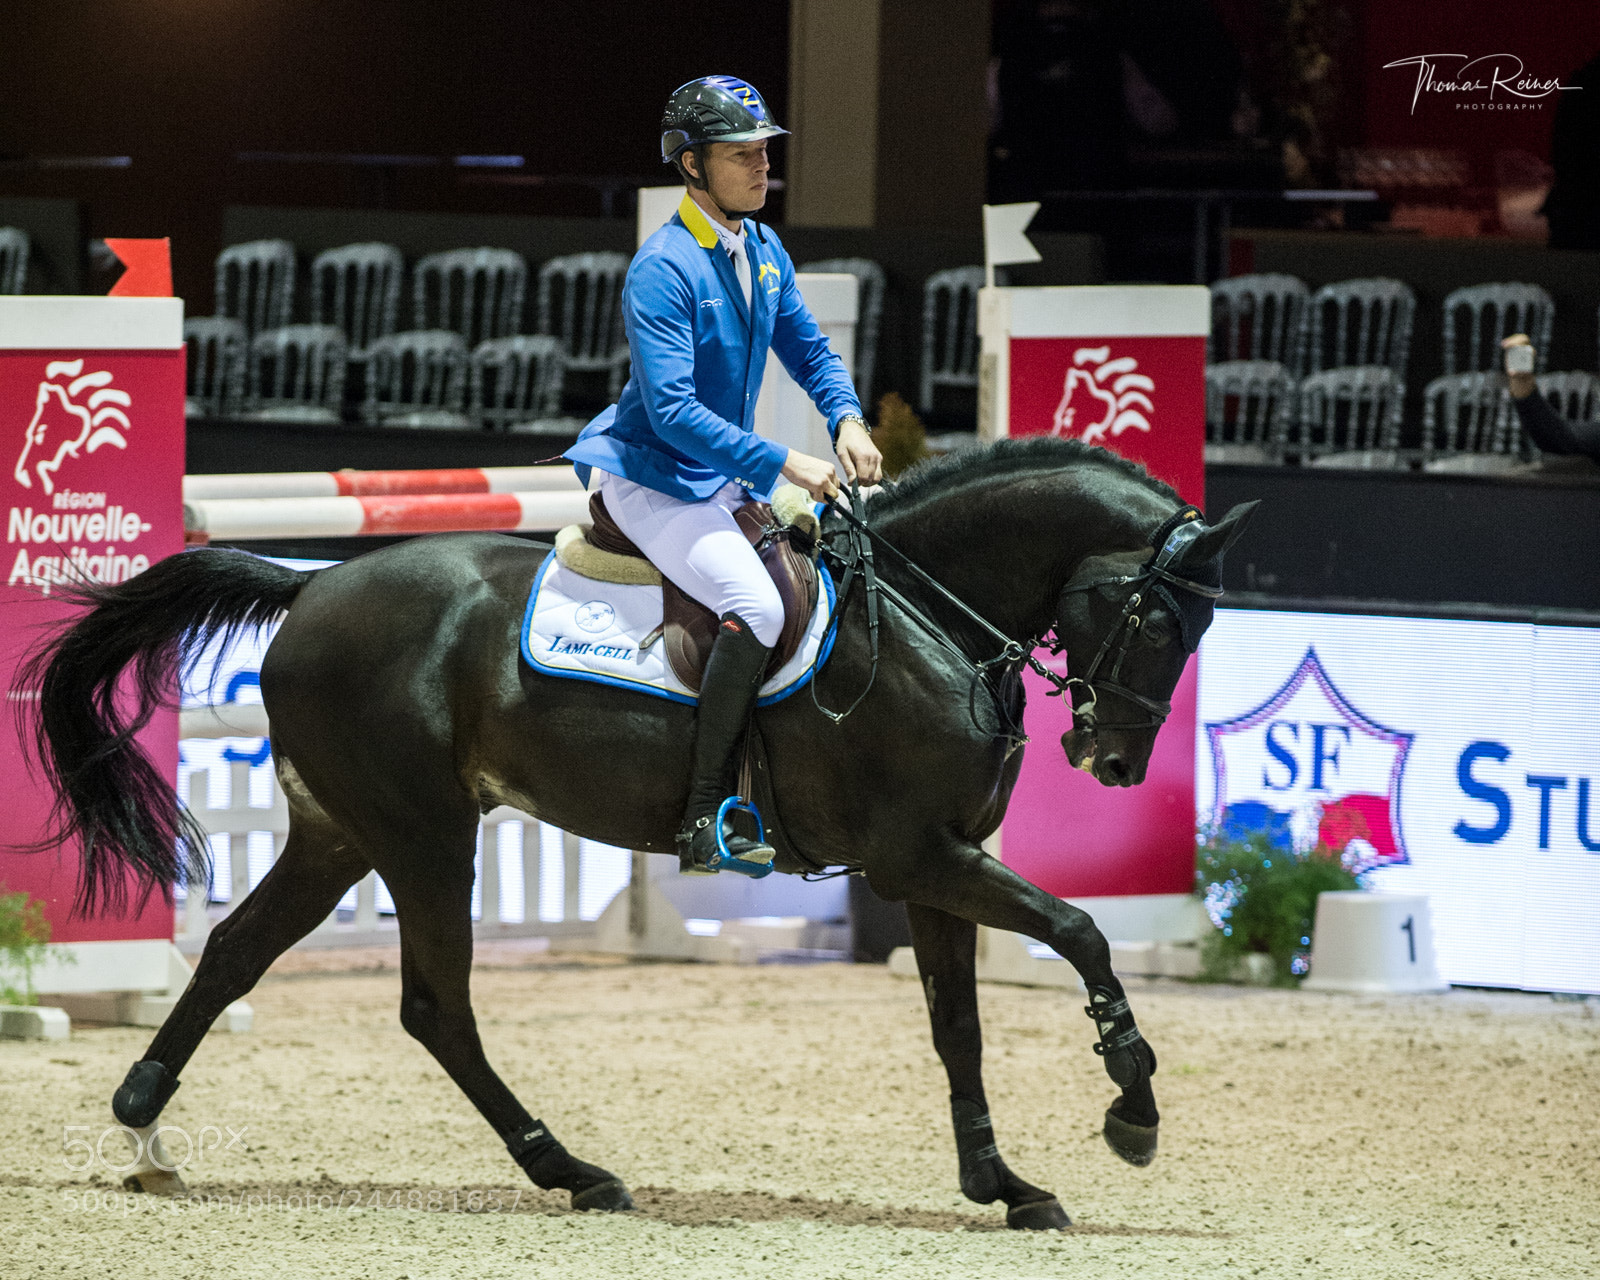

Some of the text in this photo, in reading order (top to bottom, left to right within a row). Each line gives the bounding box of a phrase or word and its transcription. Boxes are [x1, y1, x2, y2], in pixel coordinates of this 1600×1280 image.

[53, 488, 107, 509] RÉGION
[7, 505, 153, 544] Nouvelle-
[7, 545, 150, 597] Aquitaine
[547, 635, 635, 661] LAMI-CELL
[1261, 719, 1352, 792] SF
[1400, 913, 1417, 964] 1
